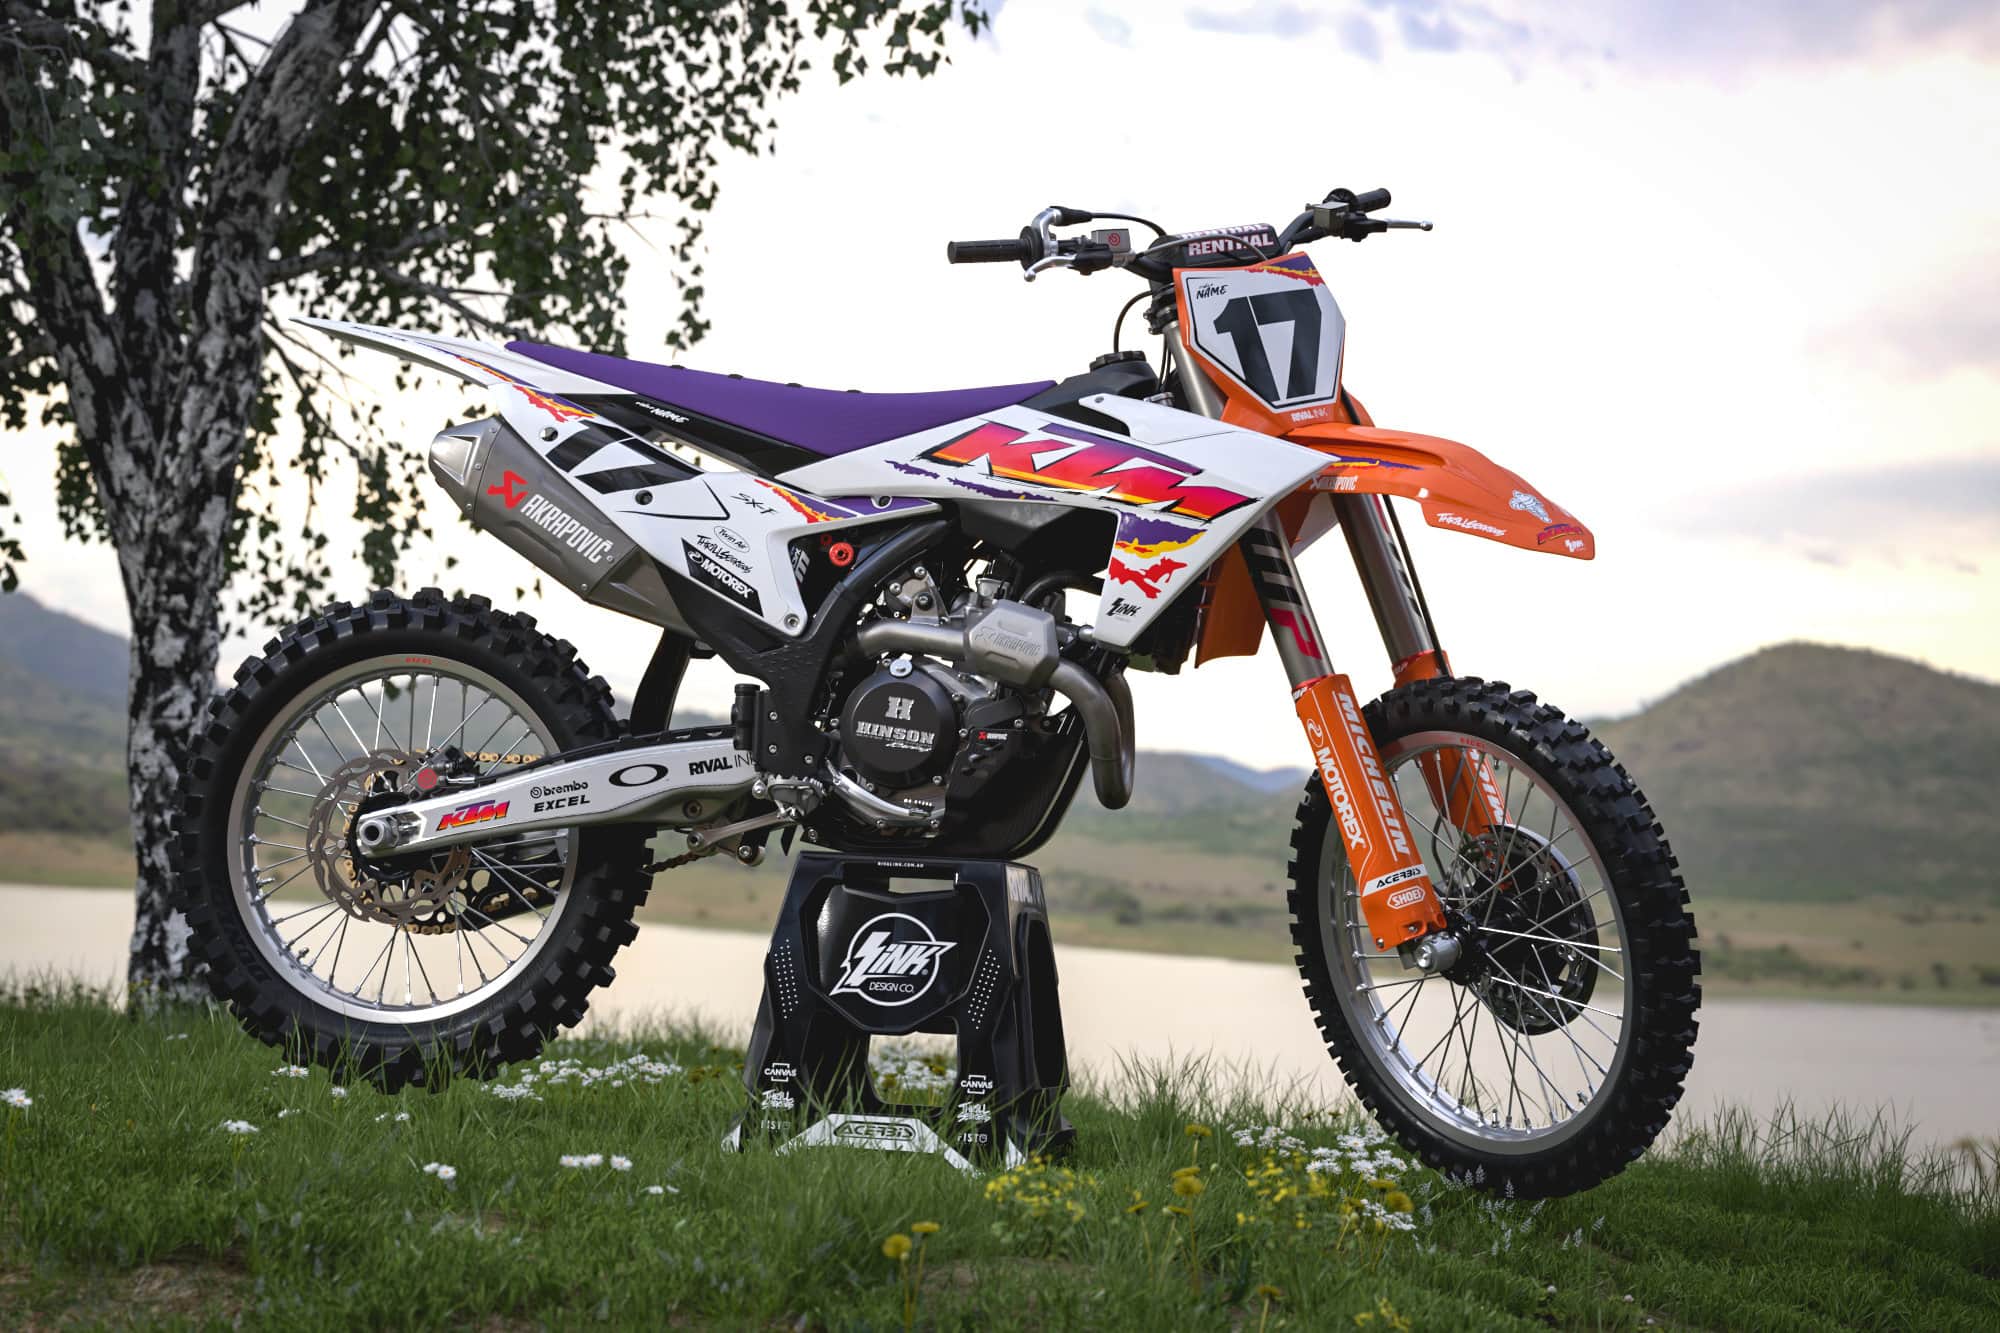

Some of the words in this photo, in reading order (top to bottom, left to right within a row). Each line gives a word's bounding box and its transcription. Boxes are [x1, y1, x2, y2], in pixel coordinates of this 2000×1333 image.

[1197, 284, 1230, 299] NAME
[1213, 288, 1322, 401] 17
[912, 420, 1262, 523] KTM
[701, 558, 753, 599] MOTOREX
[856, 721, 935, 745] HINSON
[688, 757, 733, 775] RIVAL
[1339, 692, 1411, 855] MICHELIN
[543, 780, 589, 796] brembo
[534, 795, 590, 813] EXCEL
[1316, 747, 1367, 850] MOTOREX
[436, 800, 510, 831] KTM
[1376, 867, 1421, 888] ACERBIS
[1391, 887, 1422, 907] SHOEI
[868, 981, 899, 992] DESIGN
[764, 1067, 797, 1077] CANVAS
[960, 1080, 993, 1089] CANVAS
